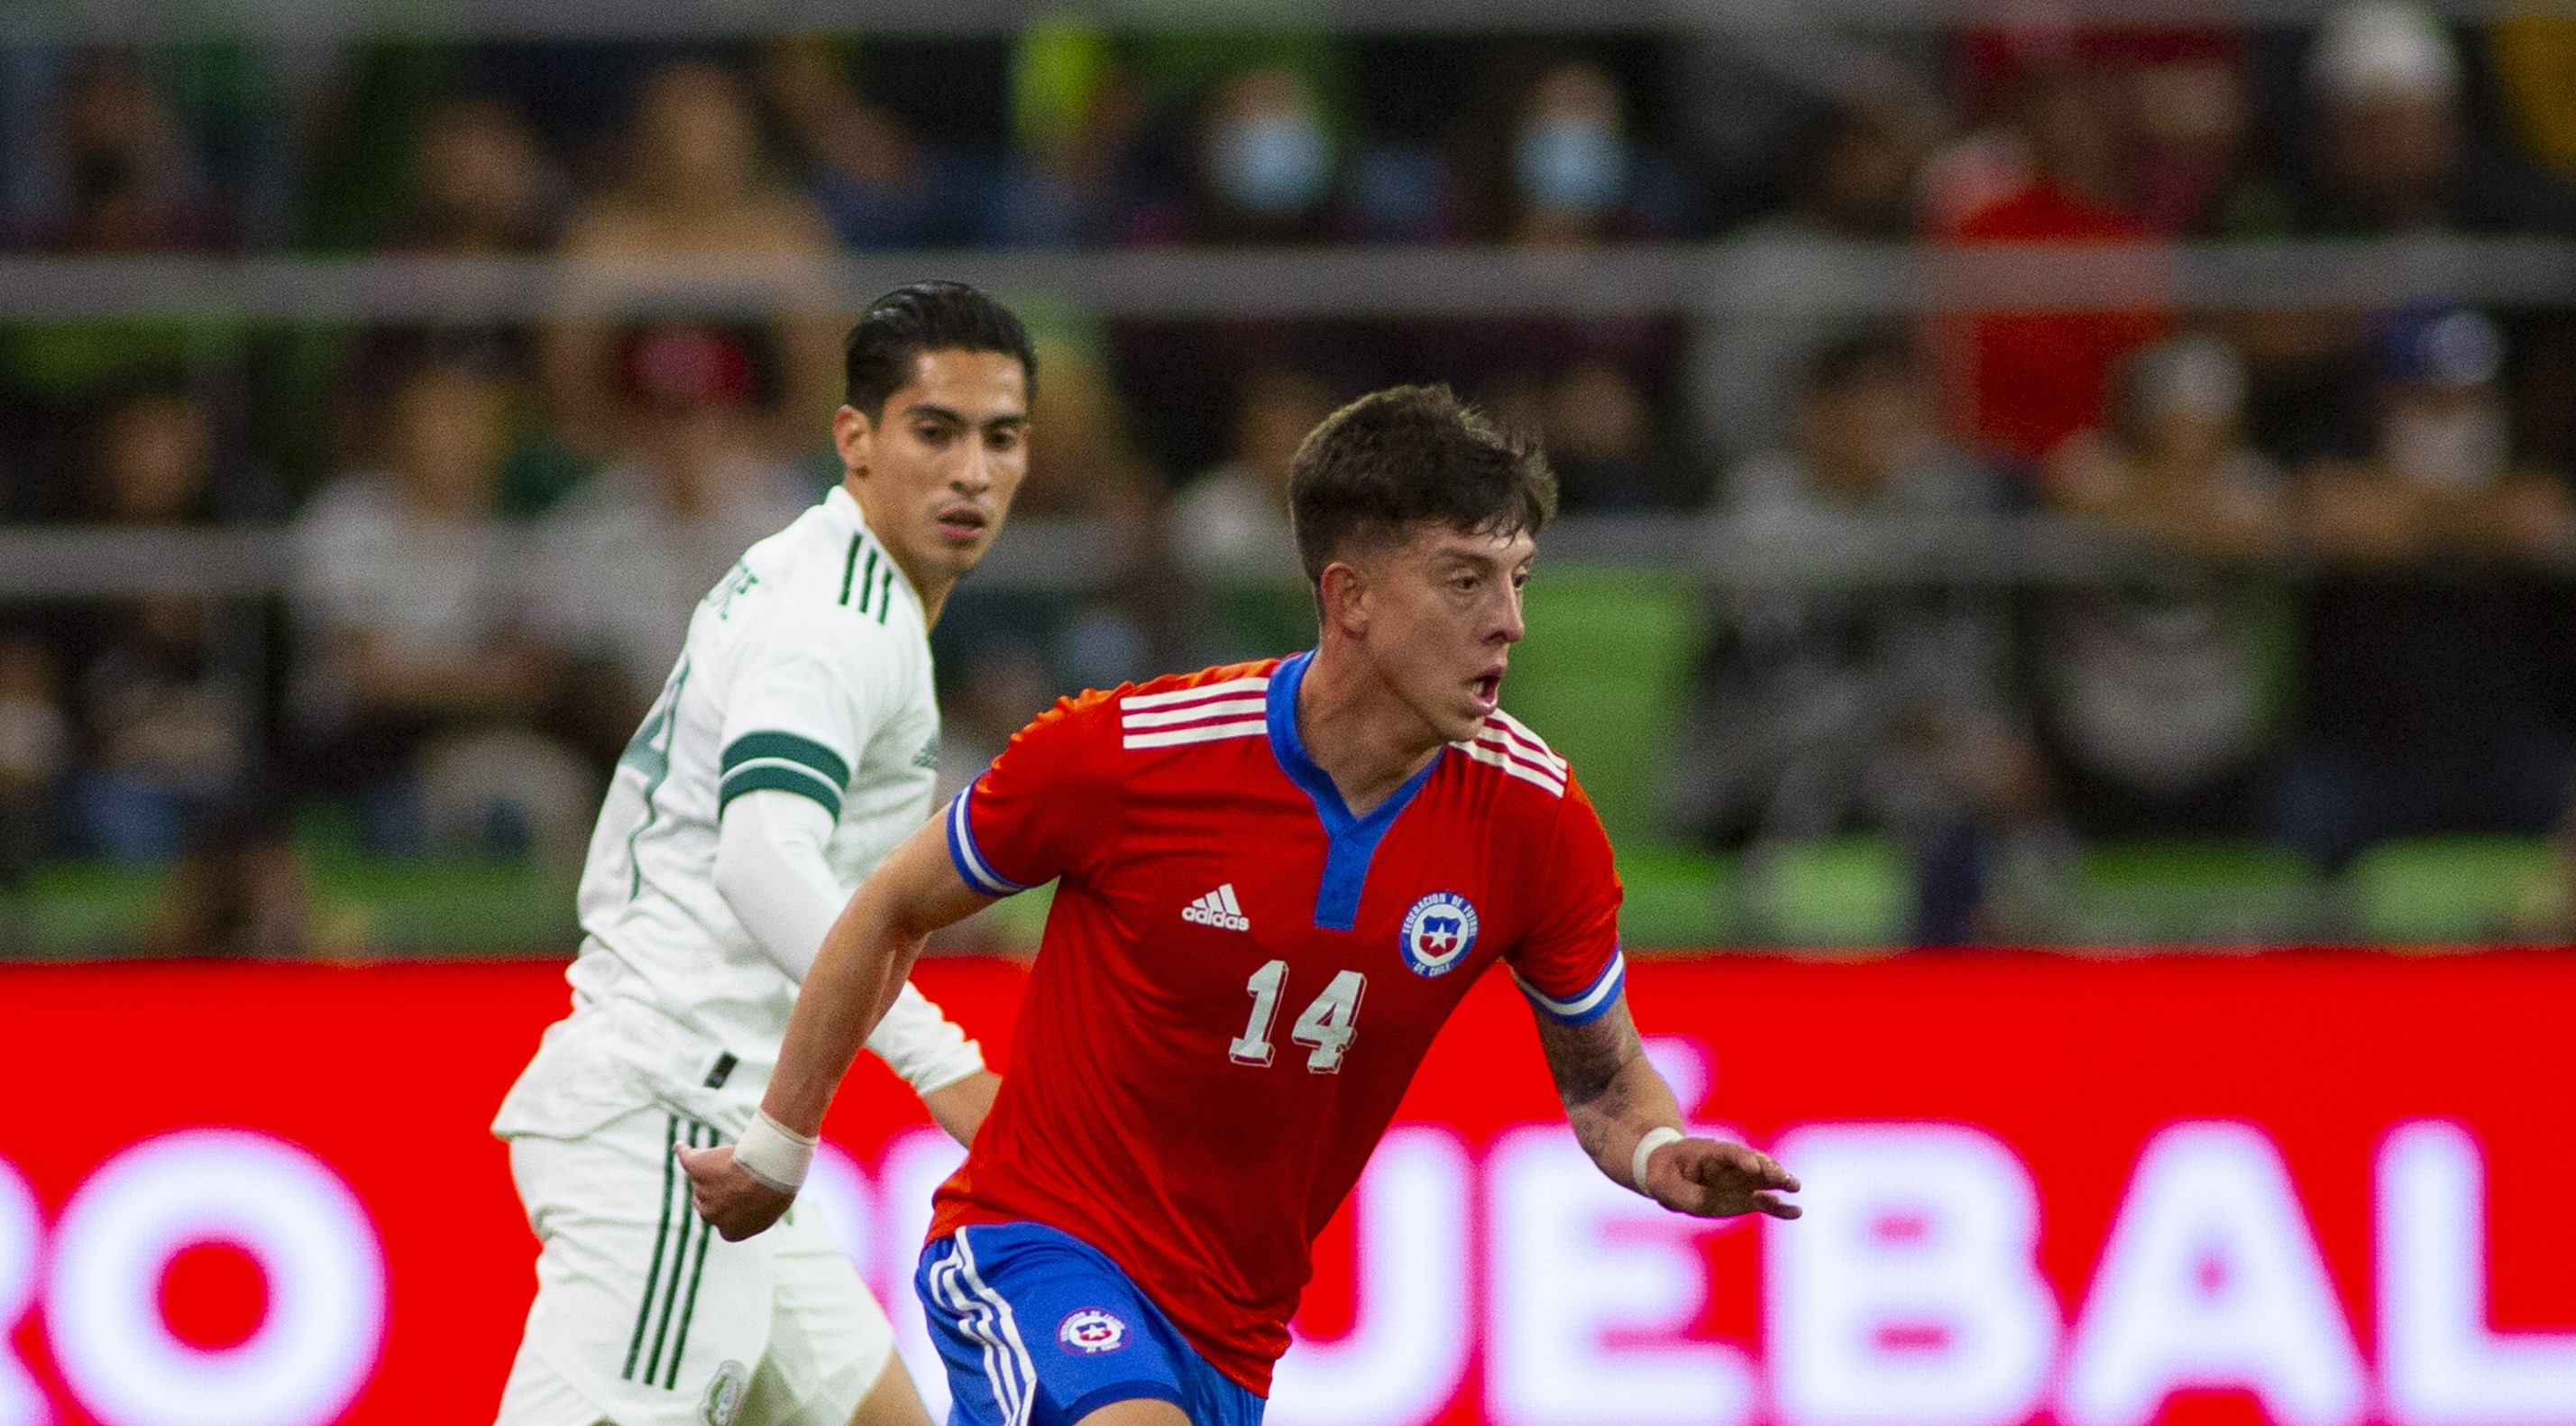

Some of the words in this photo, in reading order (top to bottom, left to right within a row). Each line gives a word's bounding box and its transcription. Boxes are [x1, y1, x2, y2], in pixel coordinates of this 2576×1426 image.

[1451, 894, 1464, 907] DE
[1181, 906, 1250, 932] adidas
[1413, 961, 1426, 975] DE
[1229, 960, 1368, 1075] 14
[0, 1127, 391, 1426] O
